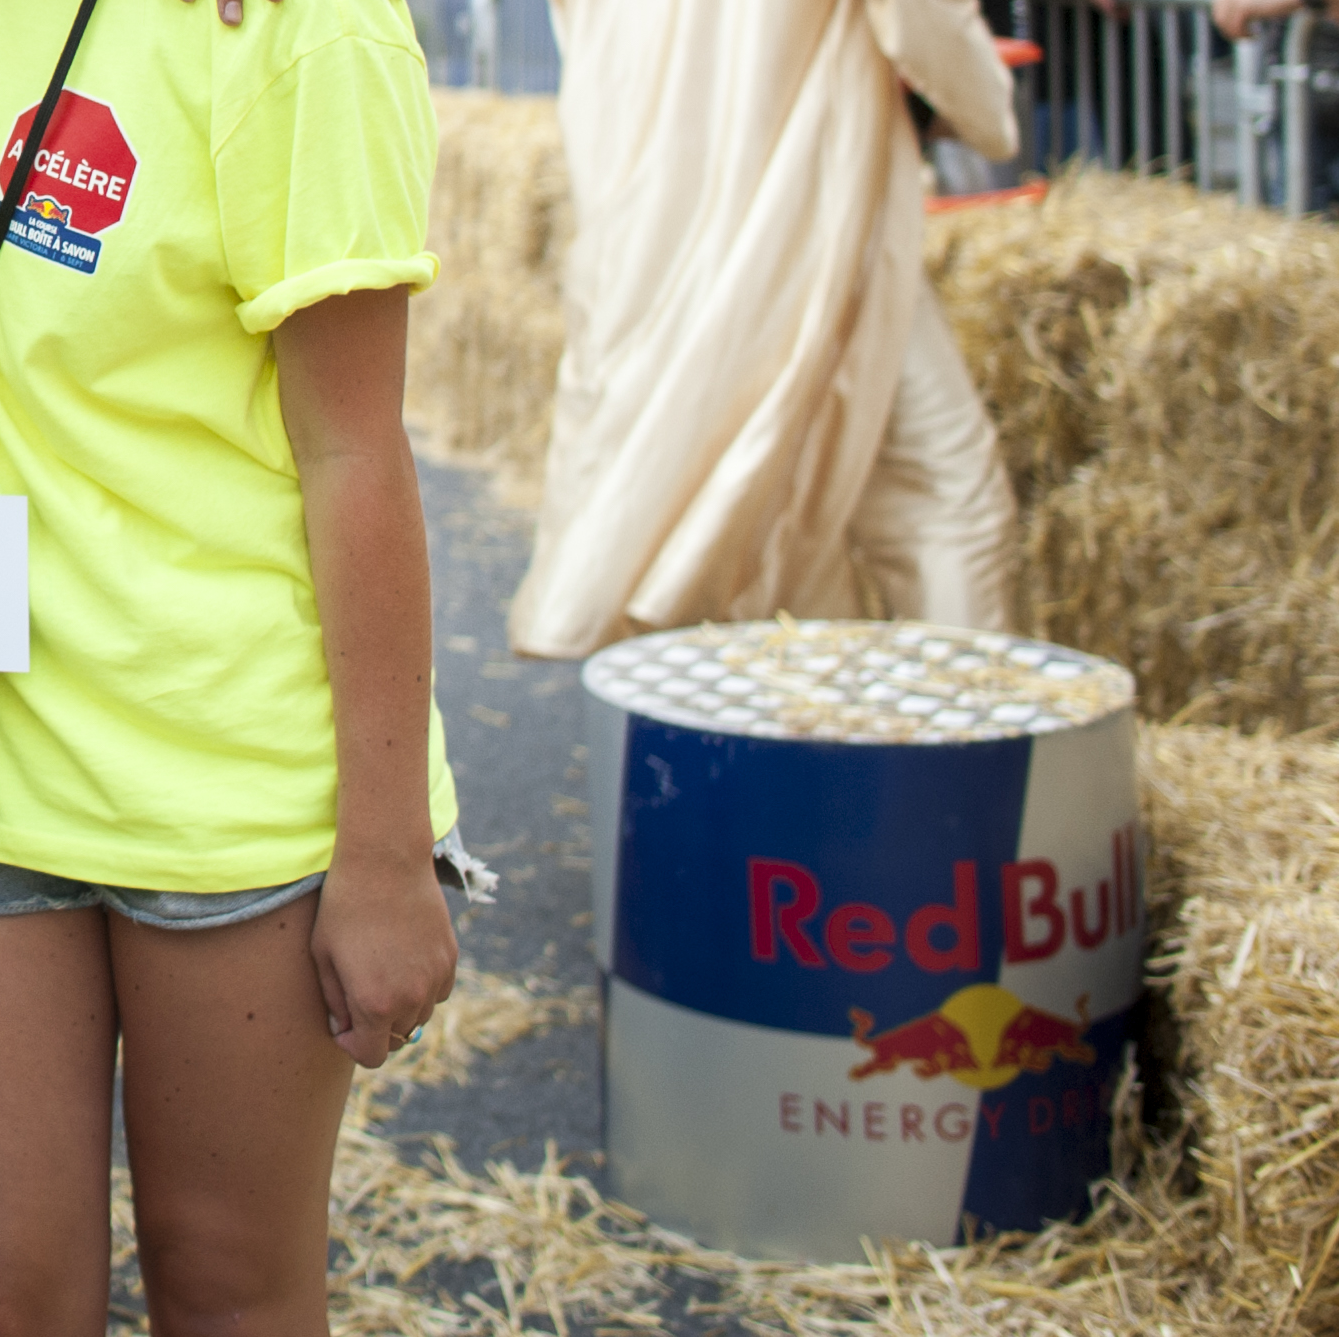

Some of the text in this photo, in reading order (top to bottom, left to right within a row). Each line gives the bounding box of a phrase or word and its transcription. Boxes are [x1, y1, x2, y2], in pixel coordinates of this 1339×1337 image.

[7, 138, 126, 201] ACÉLÈRE
[9, 220, 95, 263] BULL BOÎTE À SAVON
[28, 216, 36, 226] LA
[19, 237, 49, 255] VICTORIA
[67, 257, 85, 267] SEPT
[746, 823, 1138, 973] Red Bull
[777, 1092, 1005, 1143] ENERGY
